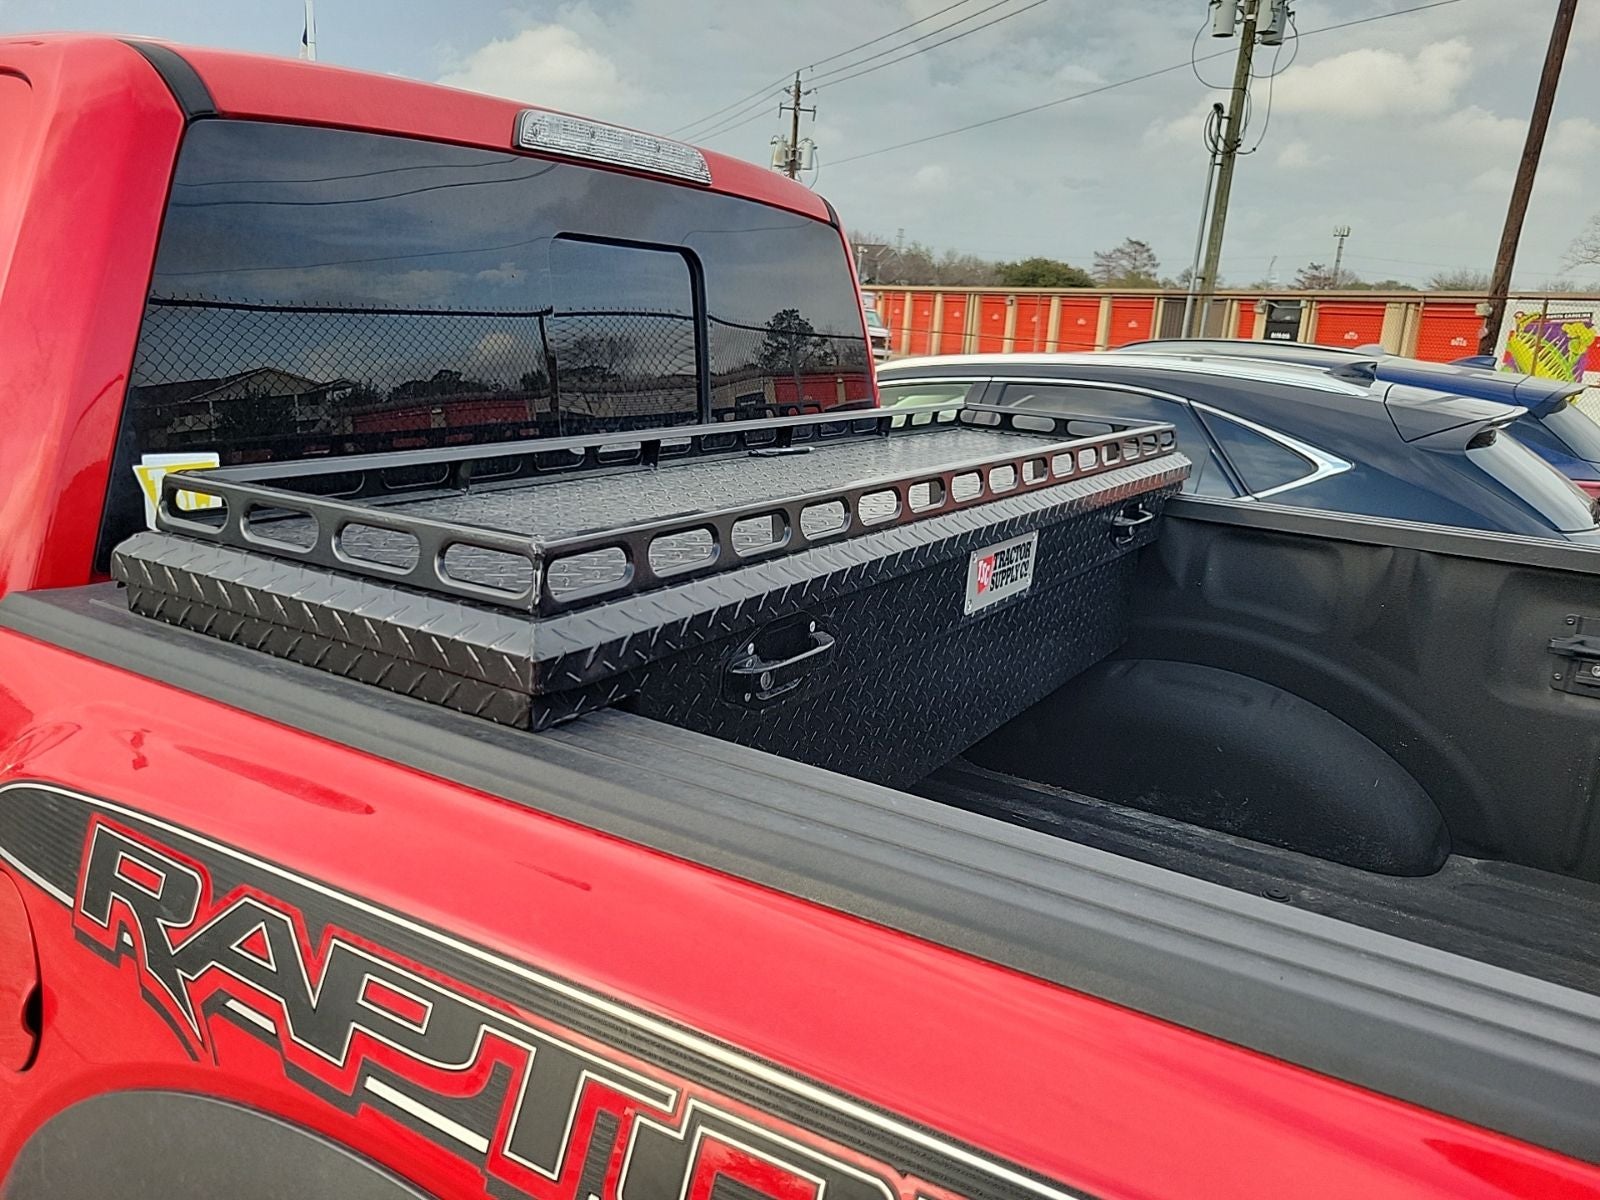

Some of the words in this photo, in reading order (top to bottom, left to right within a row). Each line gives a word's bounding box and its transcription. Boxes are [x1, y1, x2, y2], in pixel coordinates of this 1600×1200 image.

[993, 541, 1032, 571] TRACTOR
[977, 560, 991, 587] TSC
[989, 563, 1021, 592] SUPPLY
[80, 821, 928, 1200] RAPT
